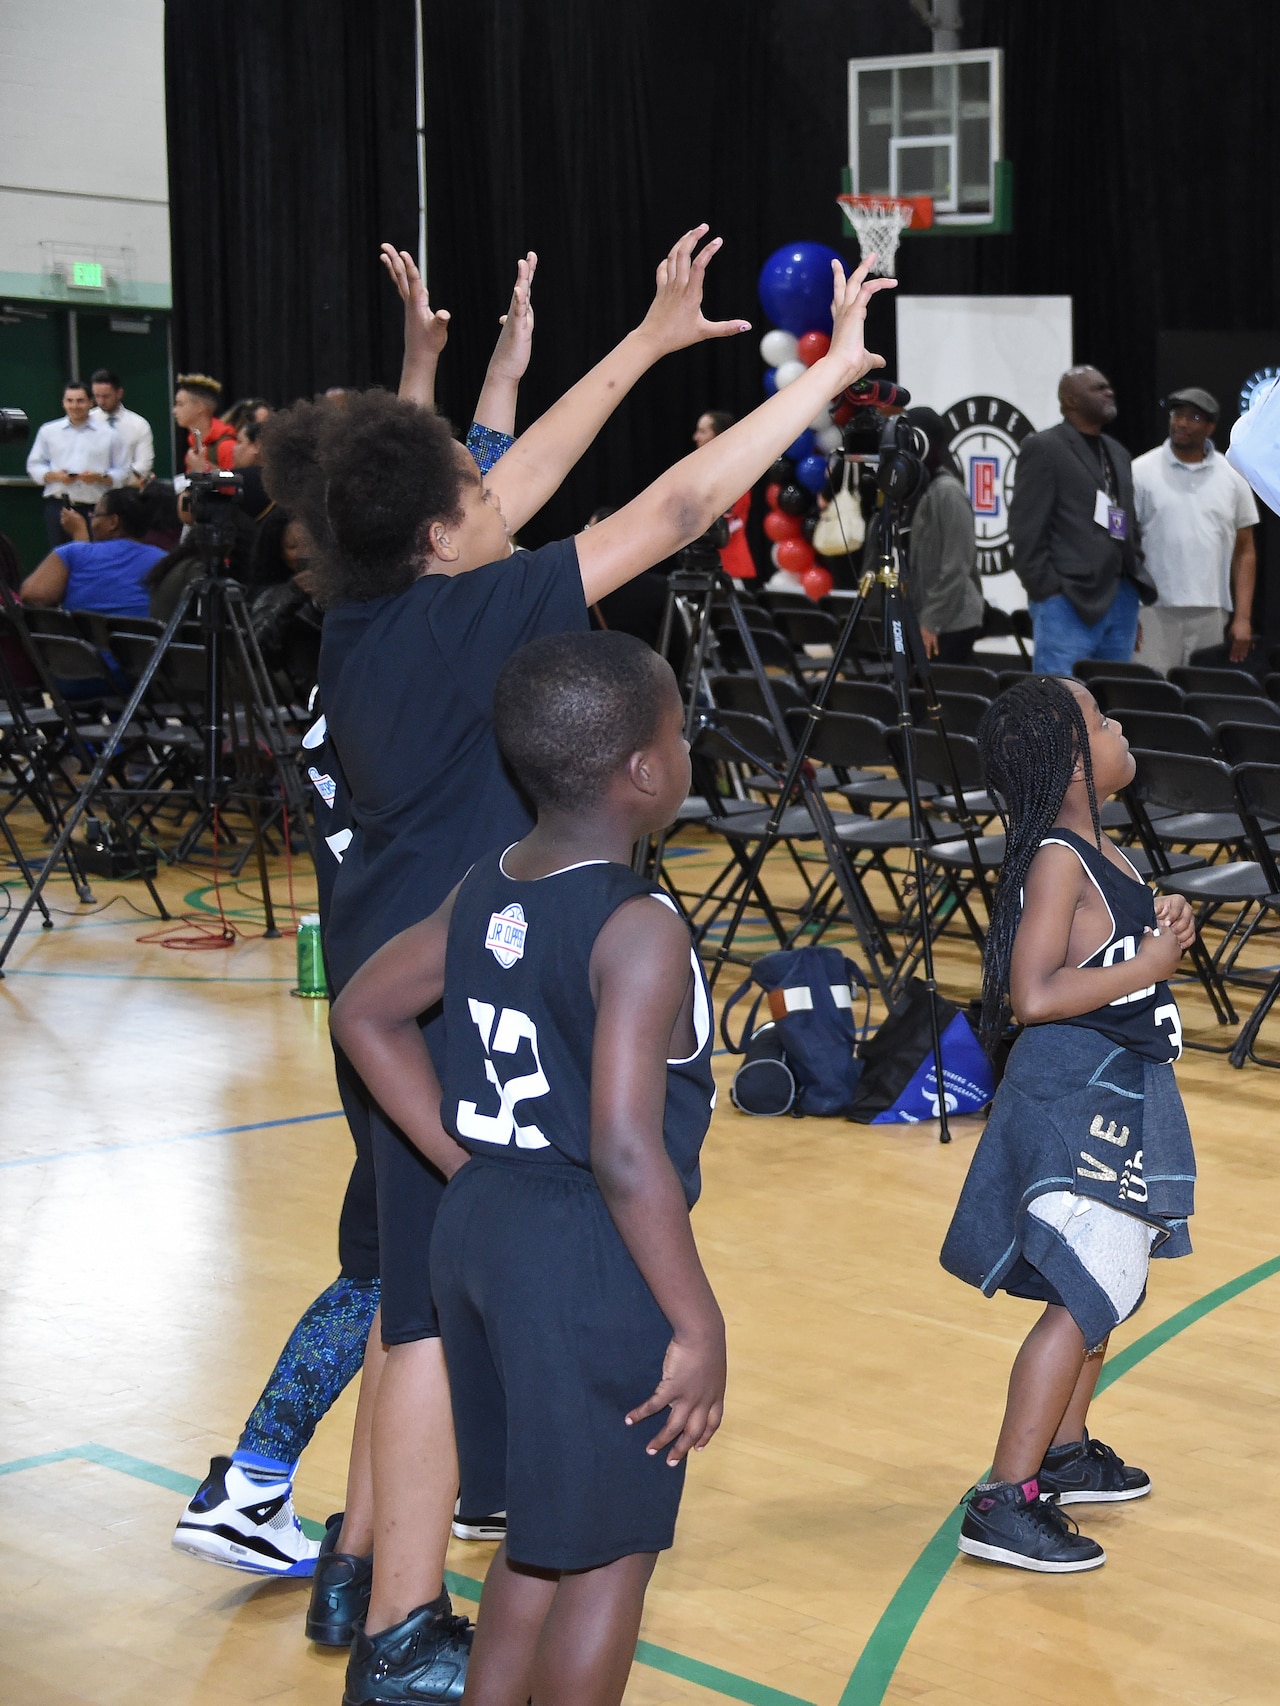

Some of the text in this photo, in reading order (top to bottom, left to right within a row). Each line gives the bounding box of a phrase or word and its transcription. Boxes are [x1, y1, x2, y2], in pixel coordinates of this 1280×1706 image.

[488, 922, 503, 941] JR
[457, 997, 551, 1150] 32
[967, 1081, 988, 1098] SPACE
